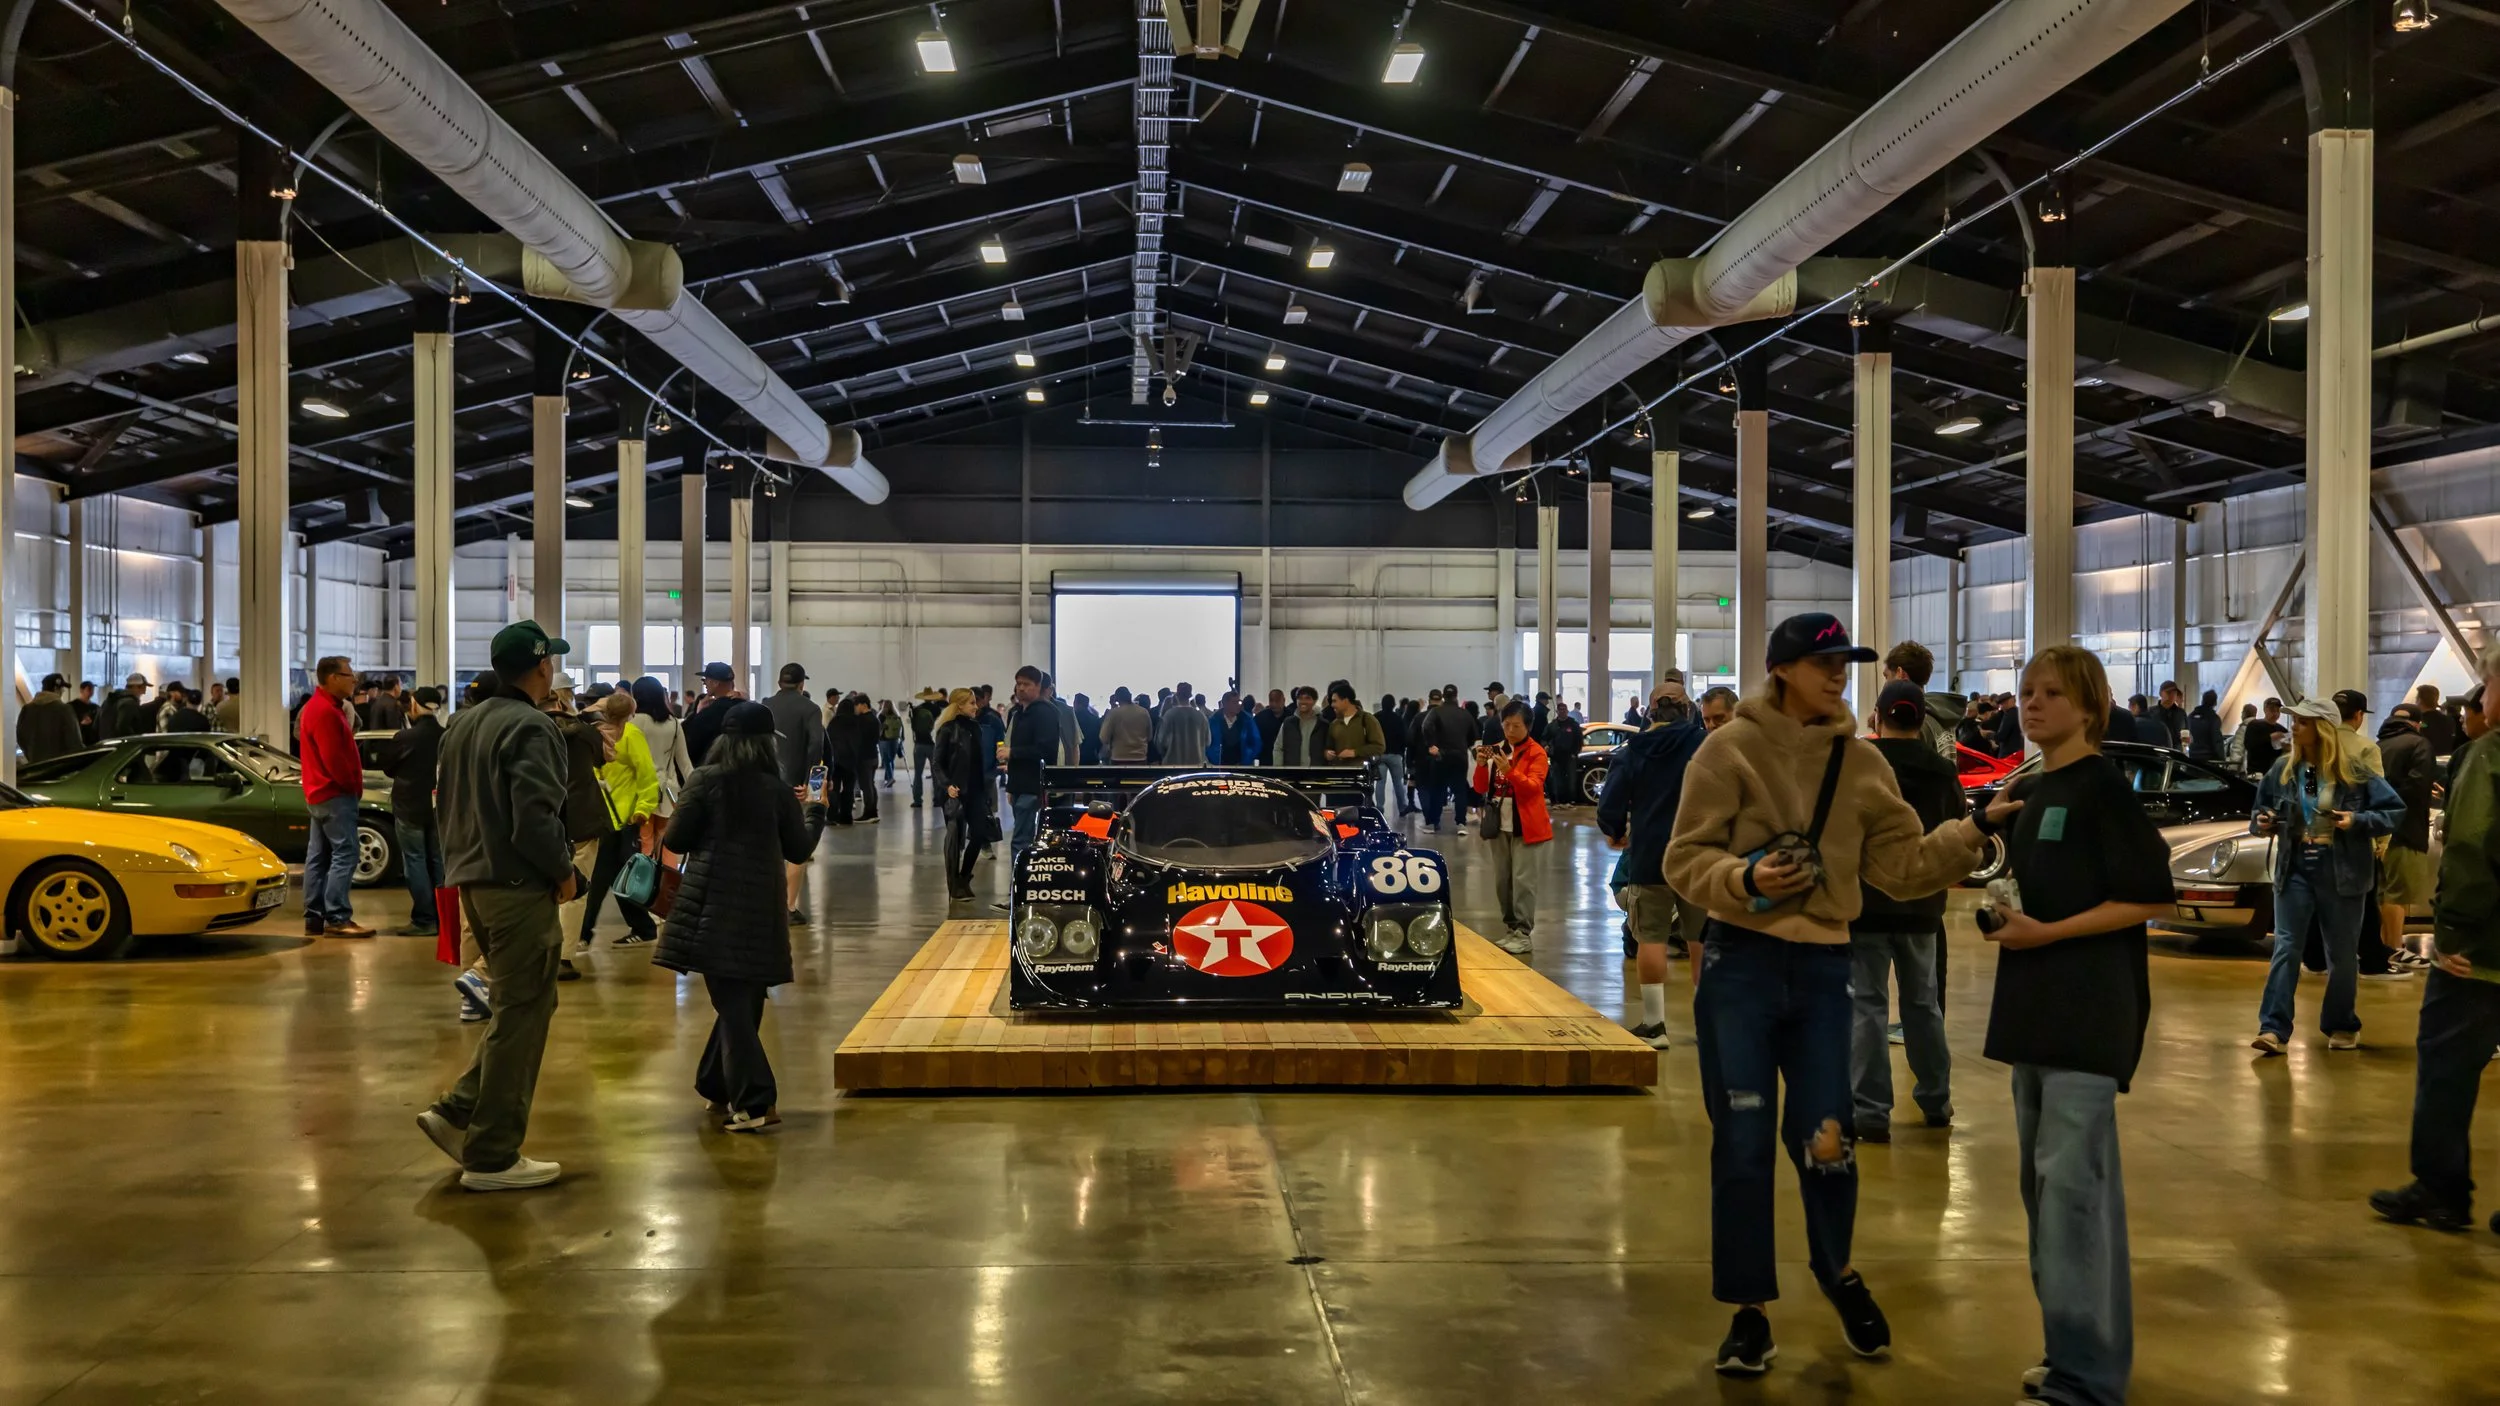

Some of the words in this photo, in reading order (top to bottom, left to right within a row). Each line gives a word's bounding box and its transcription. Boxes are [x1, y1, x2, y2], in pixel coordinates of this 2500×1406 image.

[1169, 779, 1266, 790] BAYSIDE
[1029, 856, 1066, 865] LAKE
[1027, 864, 1075, 872] UNION
[1027, 873, 1053, 882] AIR
[1371, 856, 1442, 894] 86
[1026, 889, 1086, 901] BOSCH
[1167, 881, 1294, 904] Havoline
[1034, 963, 1095, 974] Raychem
[1376, 962, 1436, 973] Raychem
[1284, 992, 1393, 1000] ANDIAL
